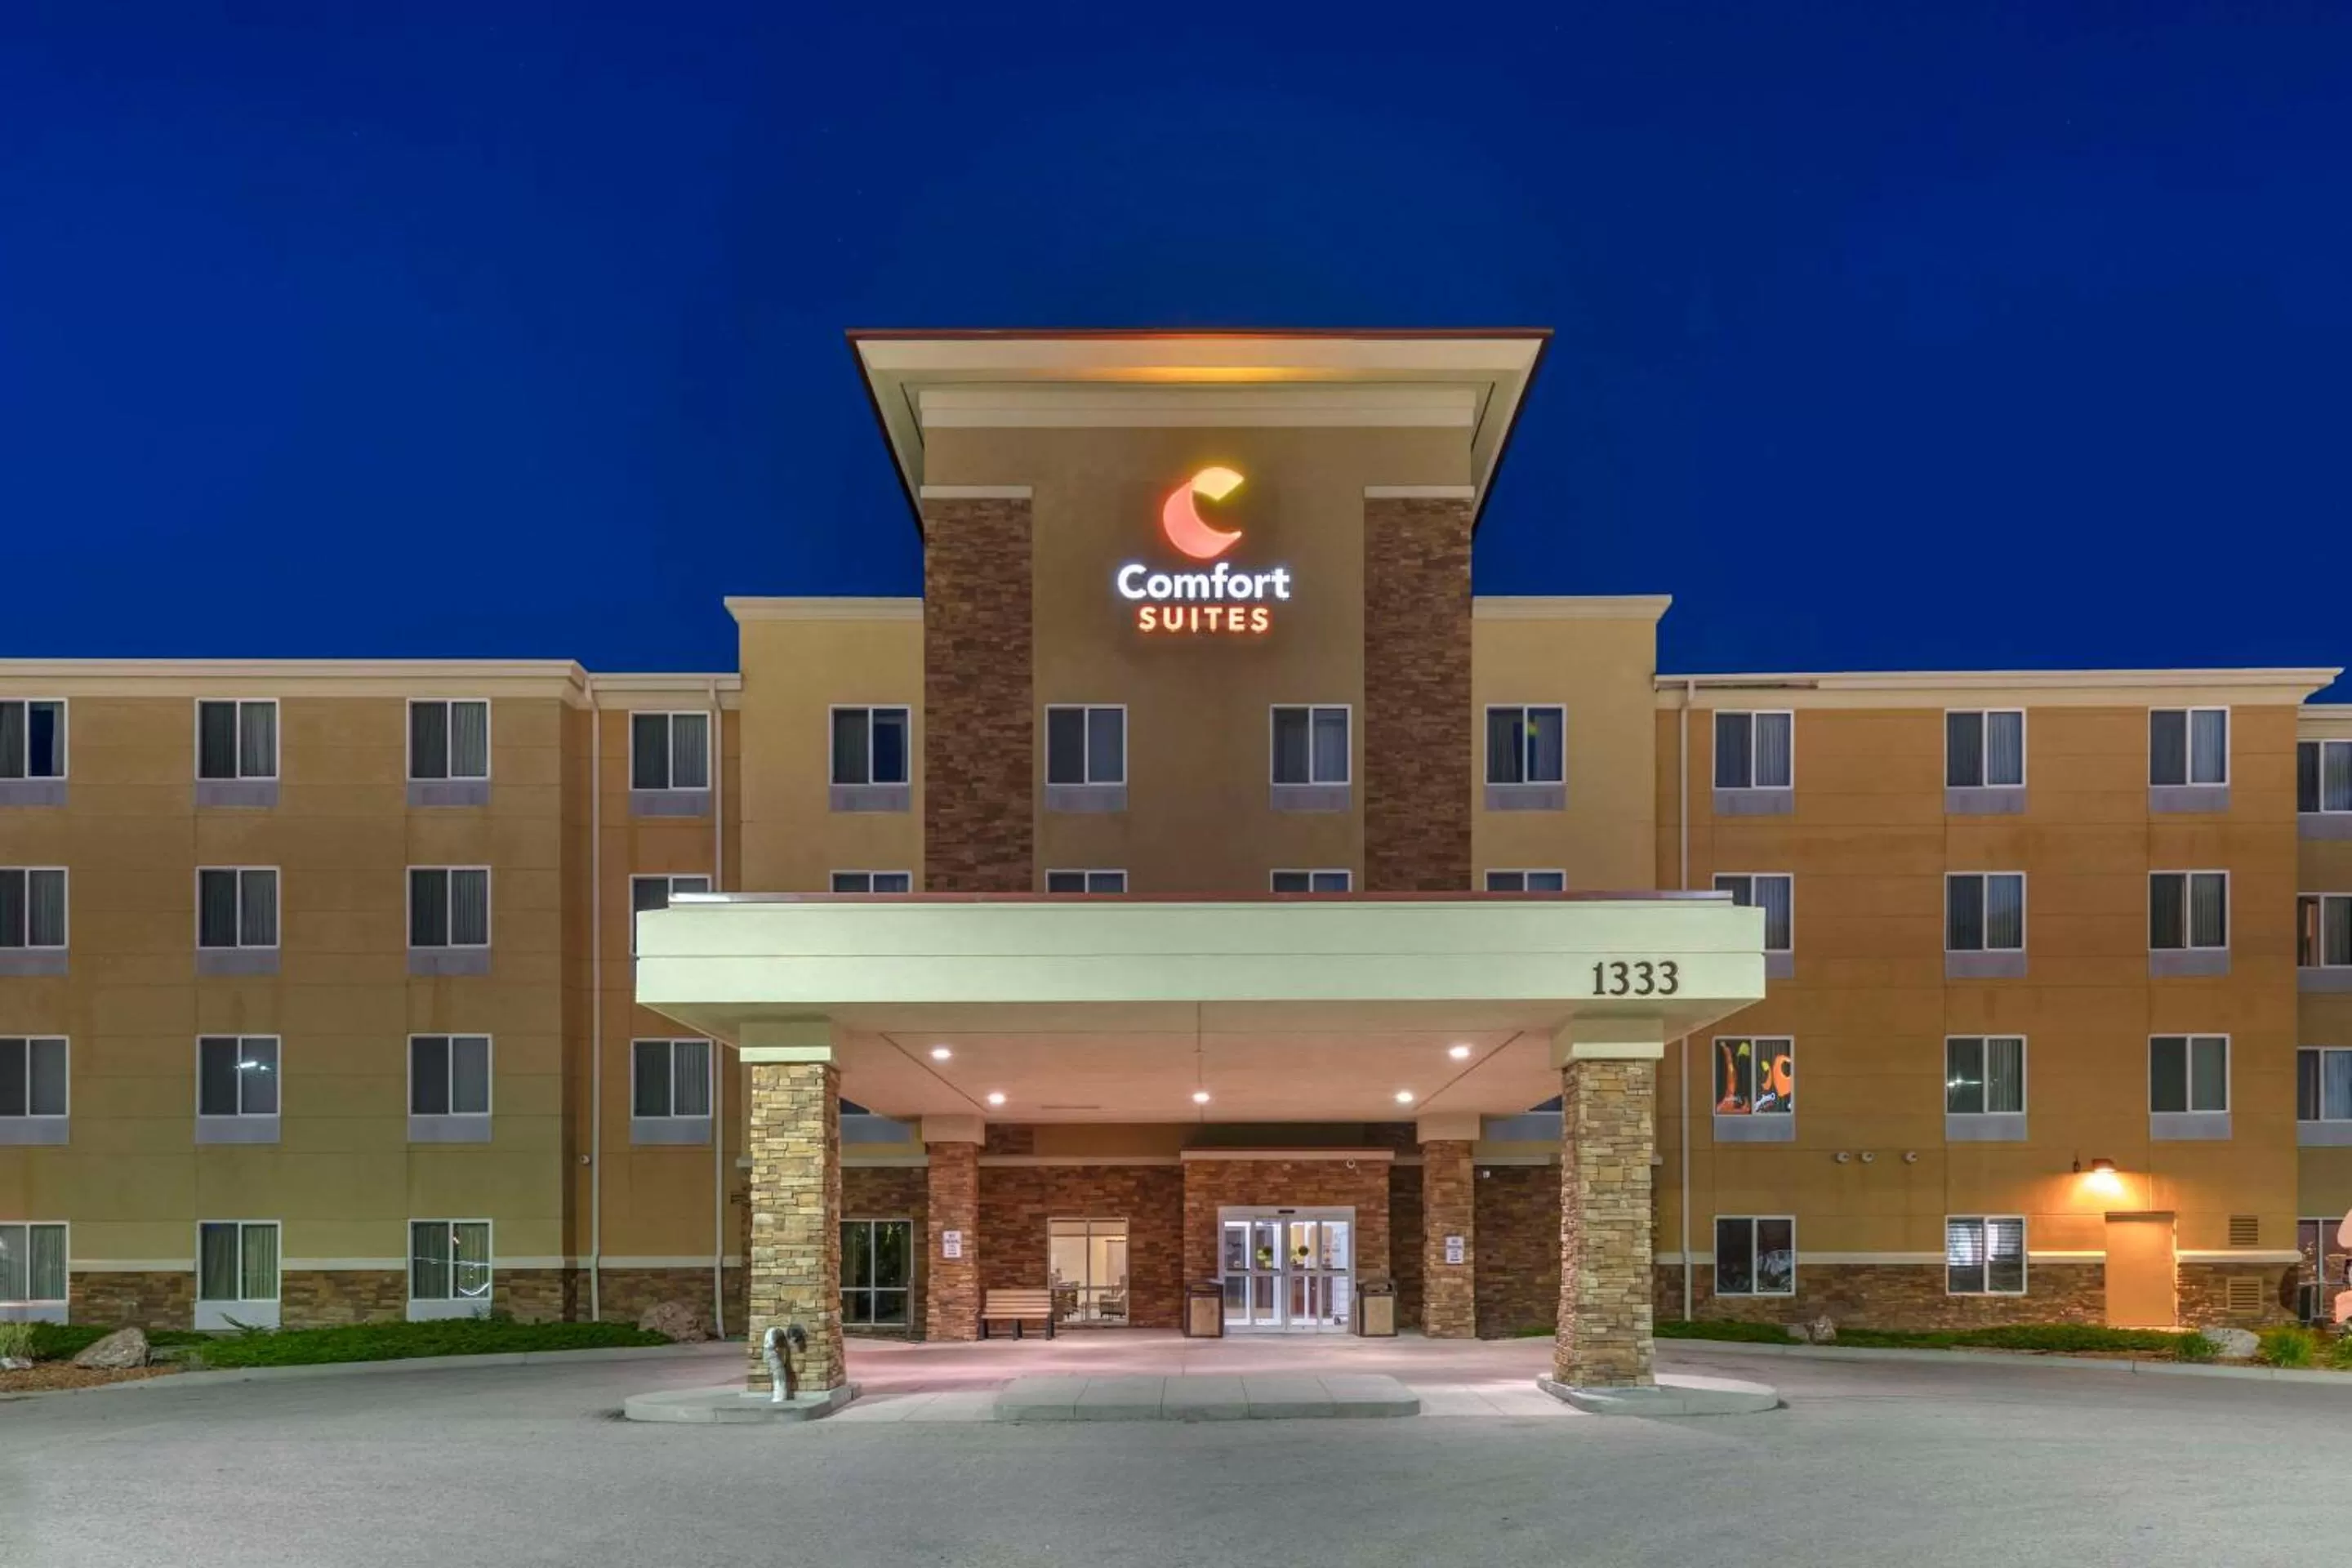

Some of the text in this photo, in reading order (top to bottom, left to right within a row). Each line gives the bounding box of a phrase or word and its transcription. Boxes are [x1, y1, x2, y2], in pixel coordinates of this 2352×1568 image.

[1117, 563, 1290, 599] Comfort
[1138, 607, 1268, 632] SUITES
[1592, 960, 1679, 996] 1333
